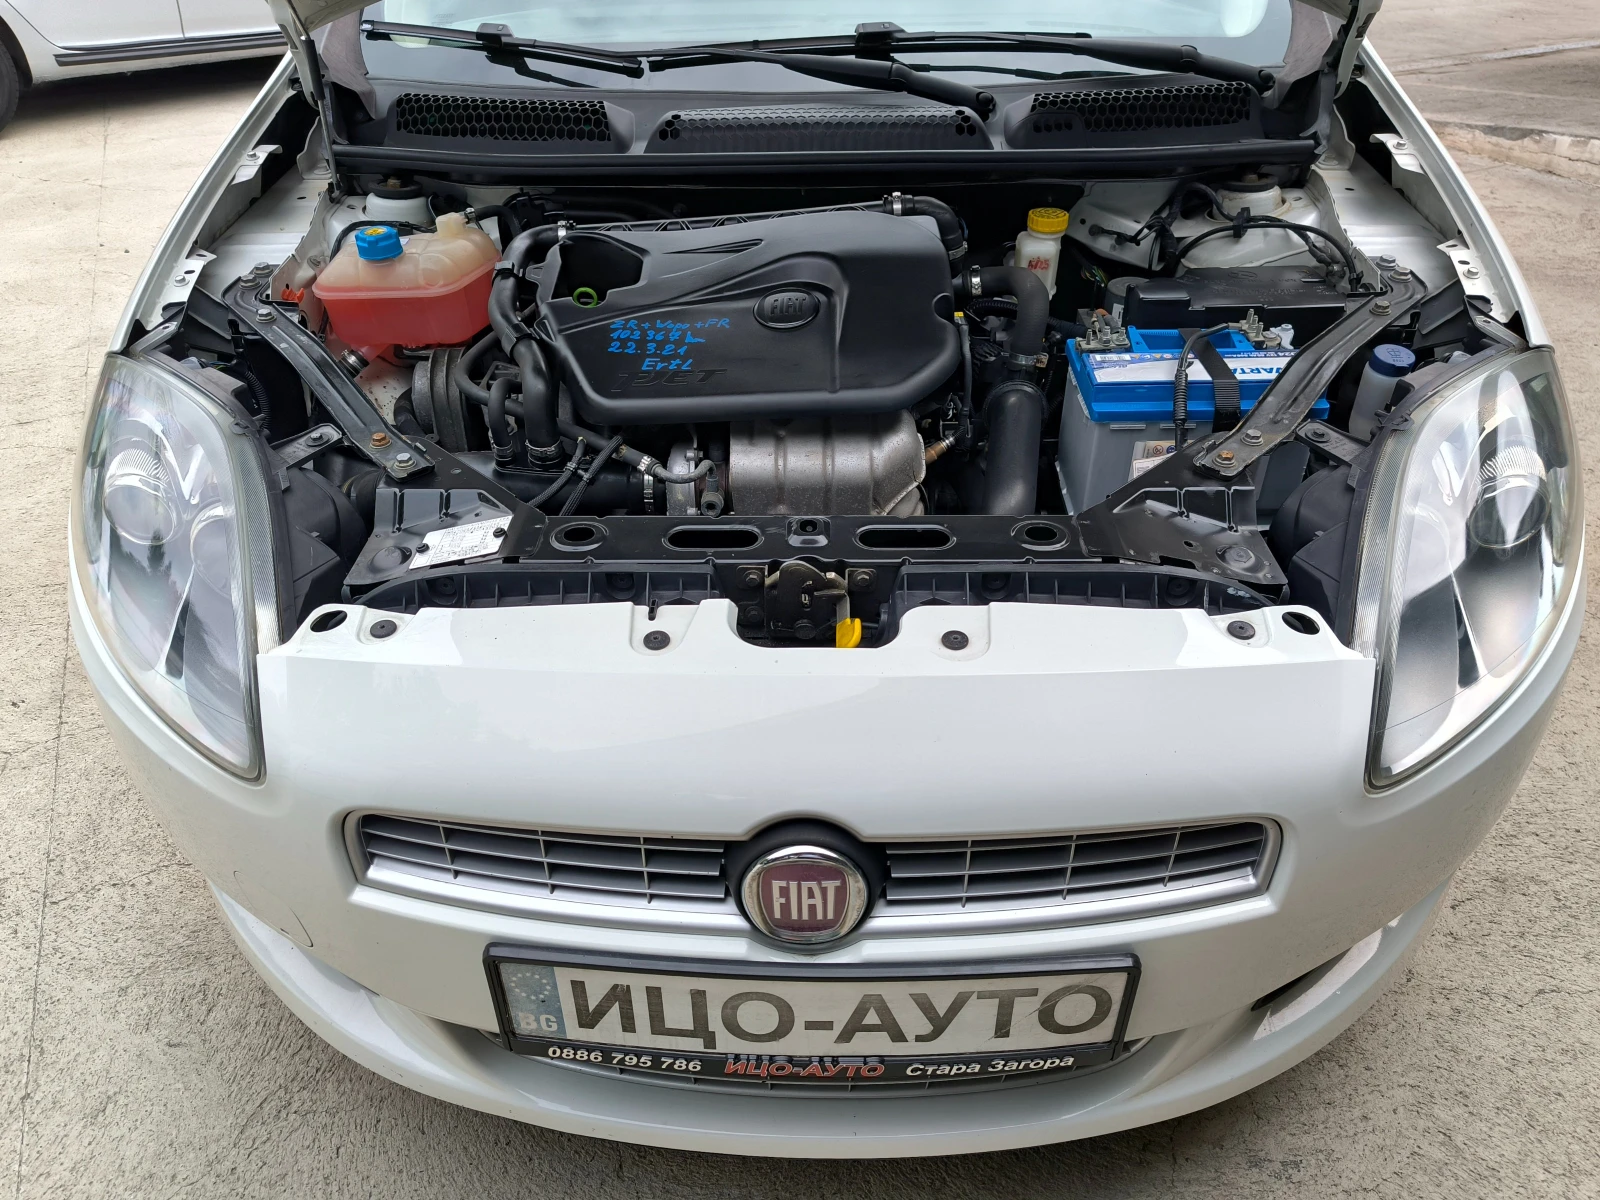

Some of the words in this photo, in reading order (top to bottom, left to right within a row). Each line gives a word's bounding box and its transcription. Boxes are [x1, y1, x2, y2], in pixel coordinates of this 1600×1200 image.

[769, 296, 807, 315] FIAT
[771, 880, 842, 921] FIAT
[518, 1010, 558, 1032] BG
[570, 979, 1113, 1050] ИЦО-АУТО
[547, 1046, 603, 1063] 0886
[611, 1052, 652, 1068] 795
[660, 1057, 702, 1072] 786
[723, 1061, 886, 1077] ИЦО-АУТО
[905, 1062, 980, 1077] Стара
[987, 1055, 1075, 1073] Загора
